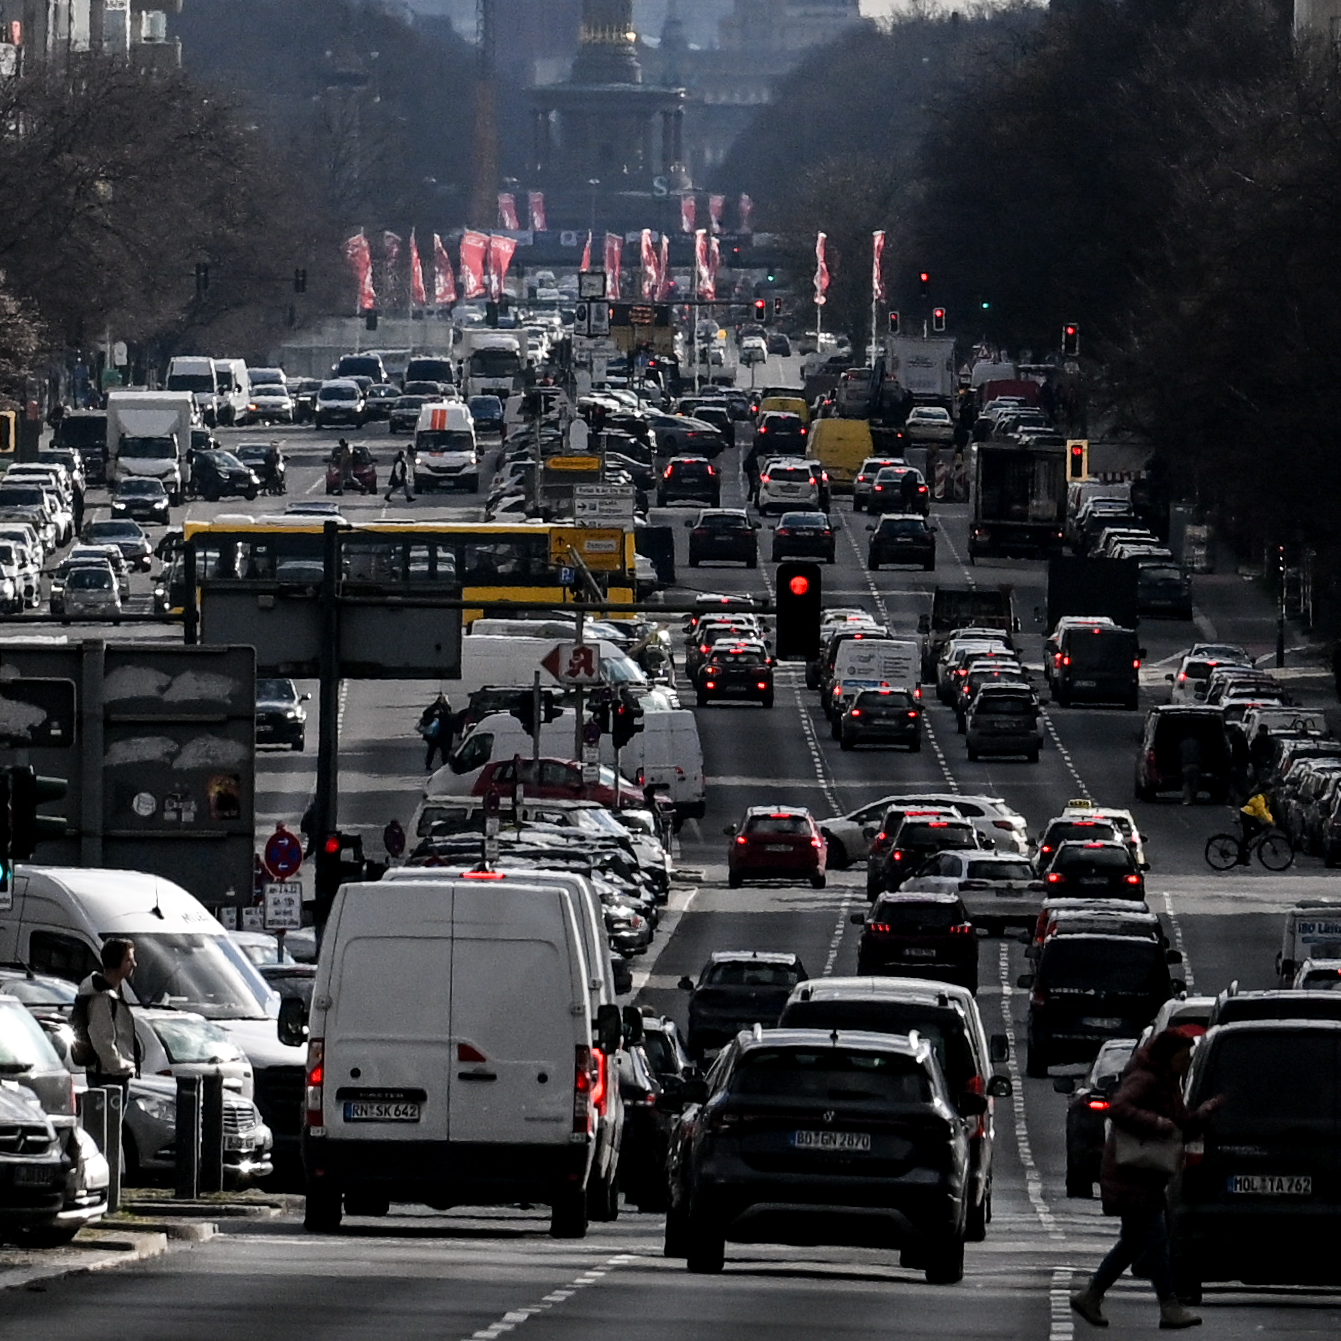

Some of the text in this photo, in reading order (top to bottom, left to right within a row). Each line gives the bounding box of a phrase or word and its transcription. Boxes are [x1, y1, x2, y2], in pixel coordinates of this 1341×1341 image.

[352, 1104, 417, 1117] RN SK 642
[1233, 1177, 1258, 1192] MOL
